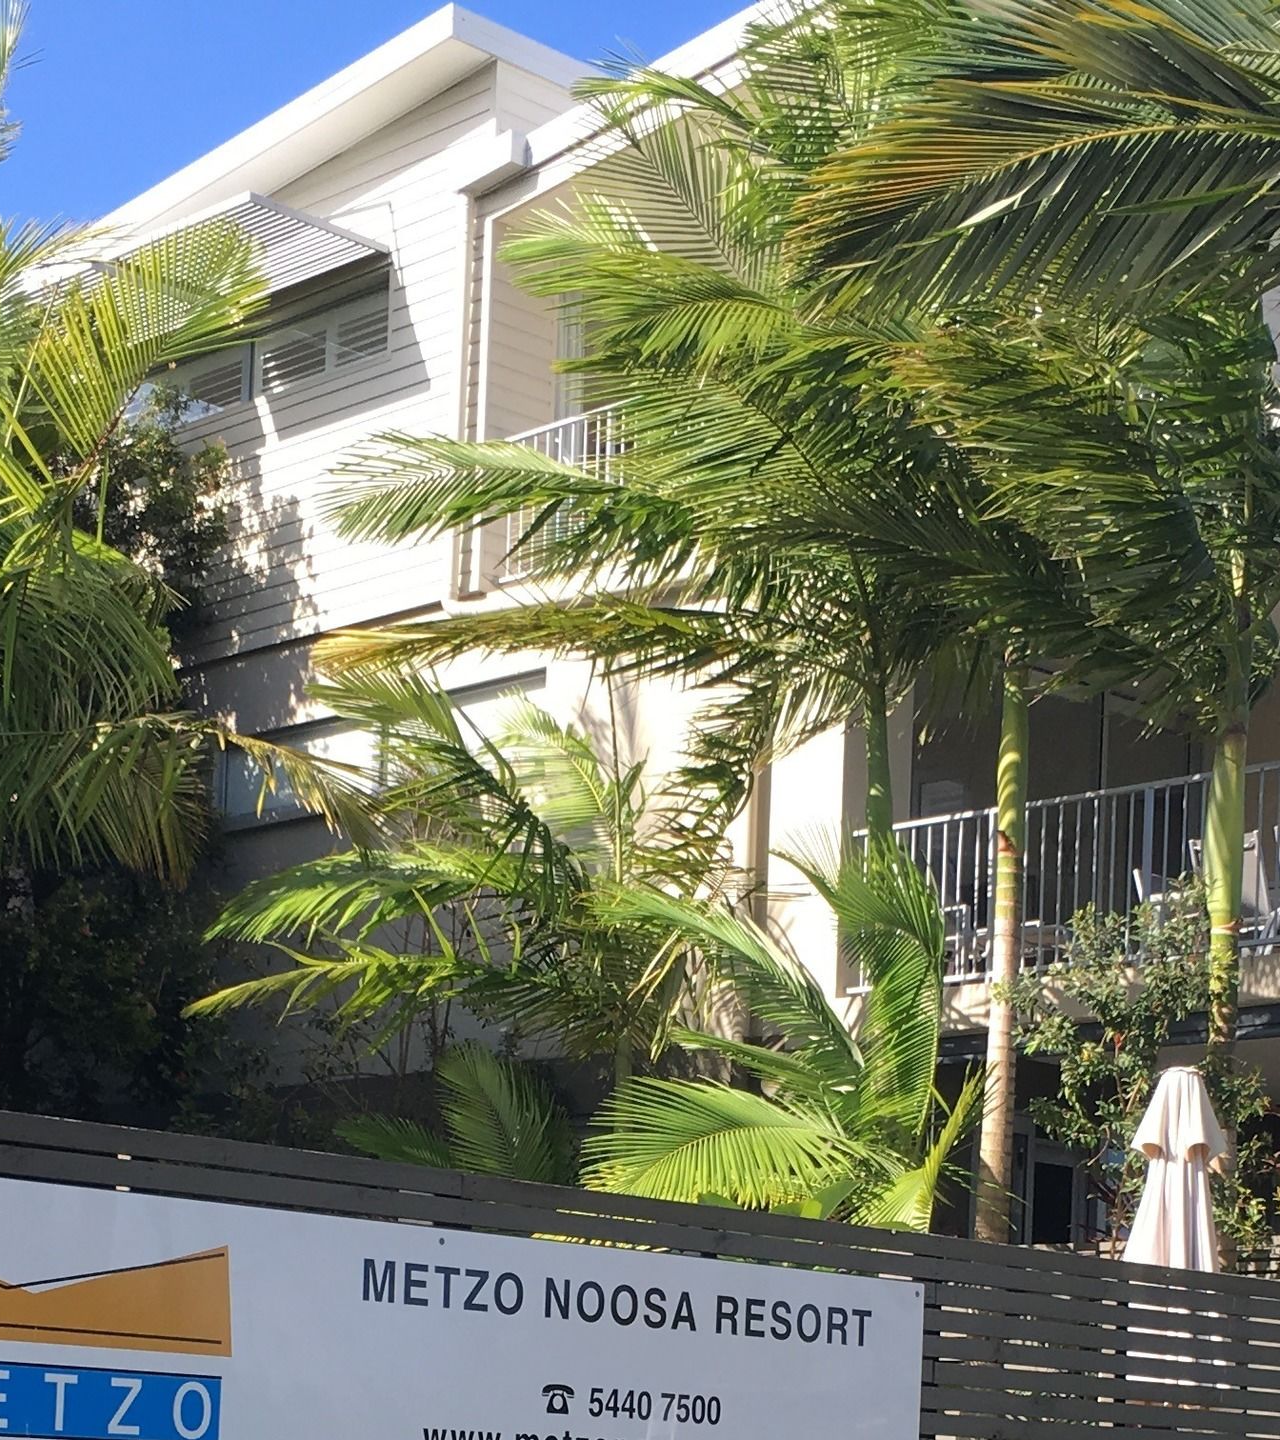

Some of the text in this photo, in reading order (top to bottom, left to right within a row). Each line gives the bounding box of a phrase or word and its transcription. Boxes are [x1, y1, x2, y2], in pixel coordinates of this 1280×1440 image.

[362, 1257, 873, 1347] METZO NOOSA RESORT
[587, 1387, 722, 1426] 5440 7500
